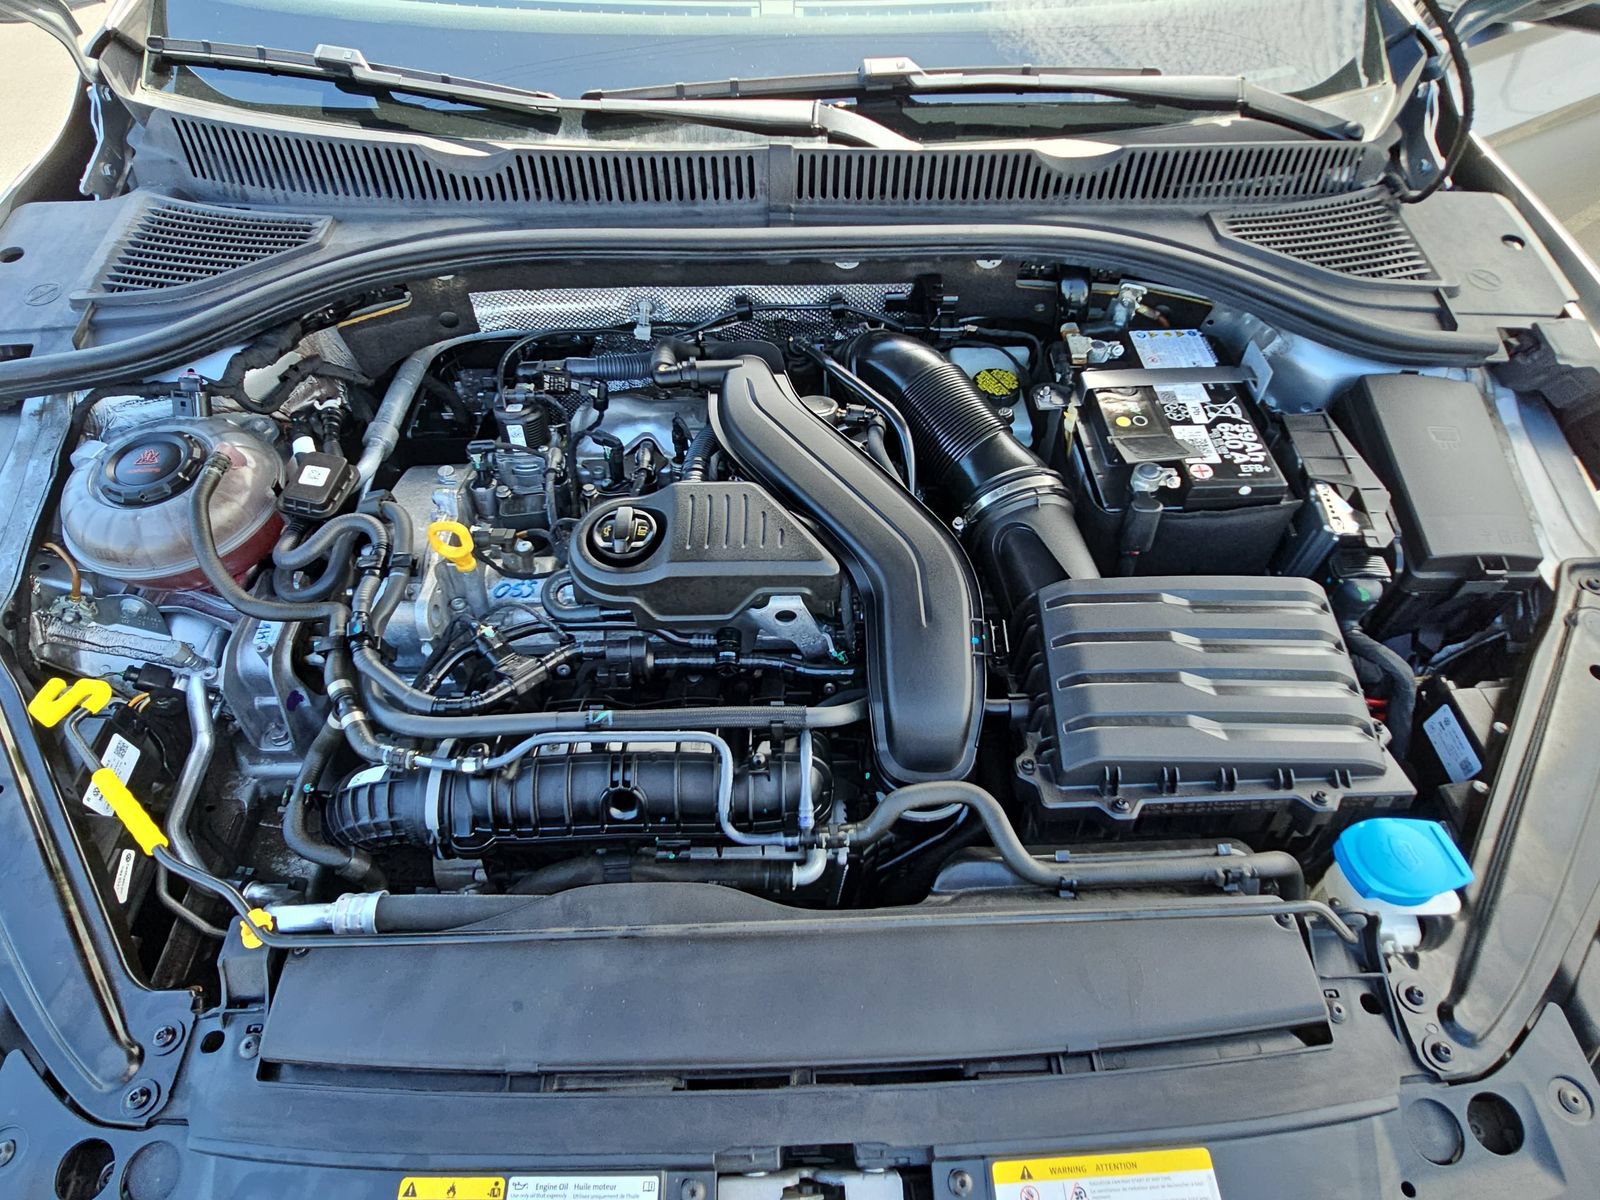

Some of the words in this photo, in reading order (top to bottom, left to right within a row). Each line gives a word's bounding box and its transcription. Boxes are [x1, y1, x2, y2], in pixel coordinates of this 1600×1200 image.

[1216, 422, 1244, 449] 640
[1230, 451, 1251, 464] A
[1234, 423, 1267, 463] 59Ah
[1048, 1166, 1087, 1175] WARNING
[1095, 1161, 1138, 1172] ATTENTION
[535, 1183, 557, 1192] Engine
[573, 1183, 591, 1191] Huile
[592, 1183, 617, 1191] moteur
